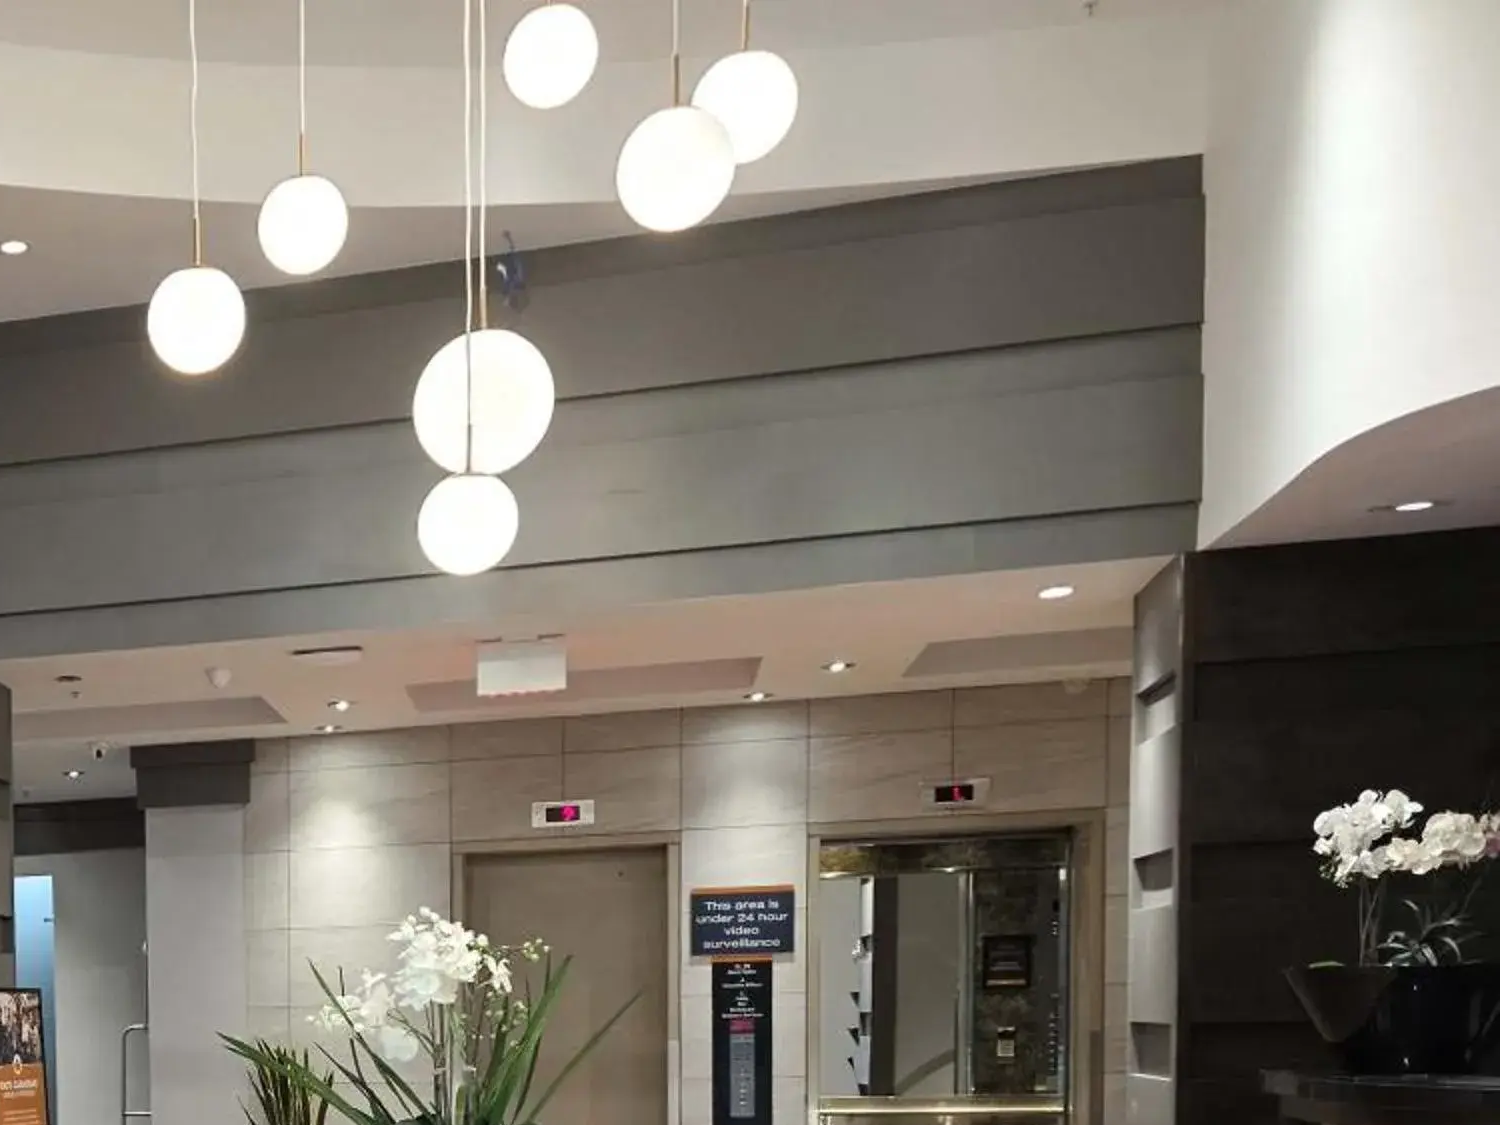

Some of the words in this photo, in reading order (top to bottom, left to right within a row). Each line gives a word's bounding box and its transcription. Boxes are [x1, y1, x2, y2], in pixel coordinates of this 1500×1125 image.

[705, 901, 731, 911] This
[735, 901, 765, 910] area
[768, 900, 779, 909] is
[695, 913, 735, 925] under
[737, 913, 755, 923] 24
[758, 912, 789, 921] hour
[723, 926, 760, 936] video
